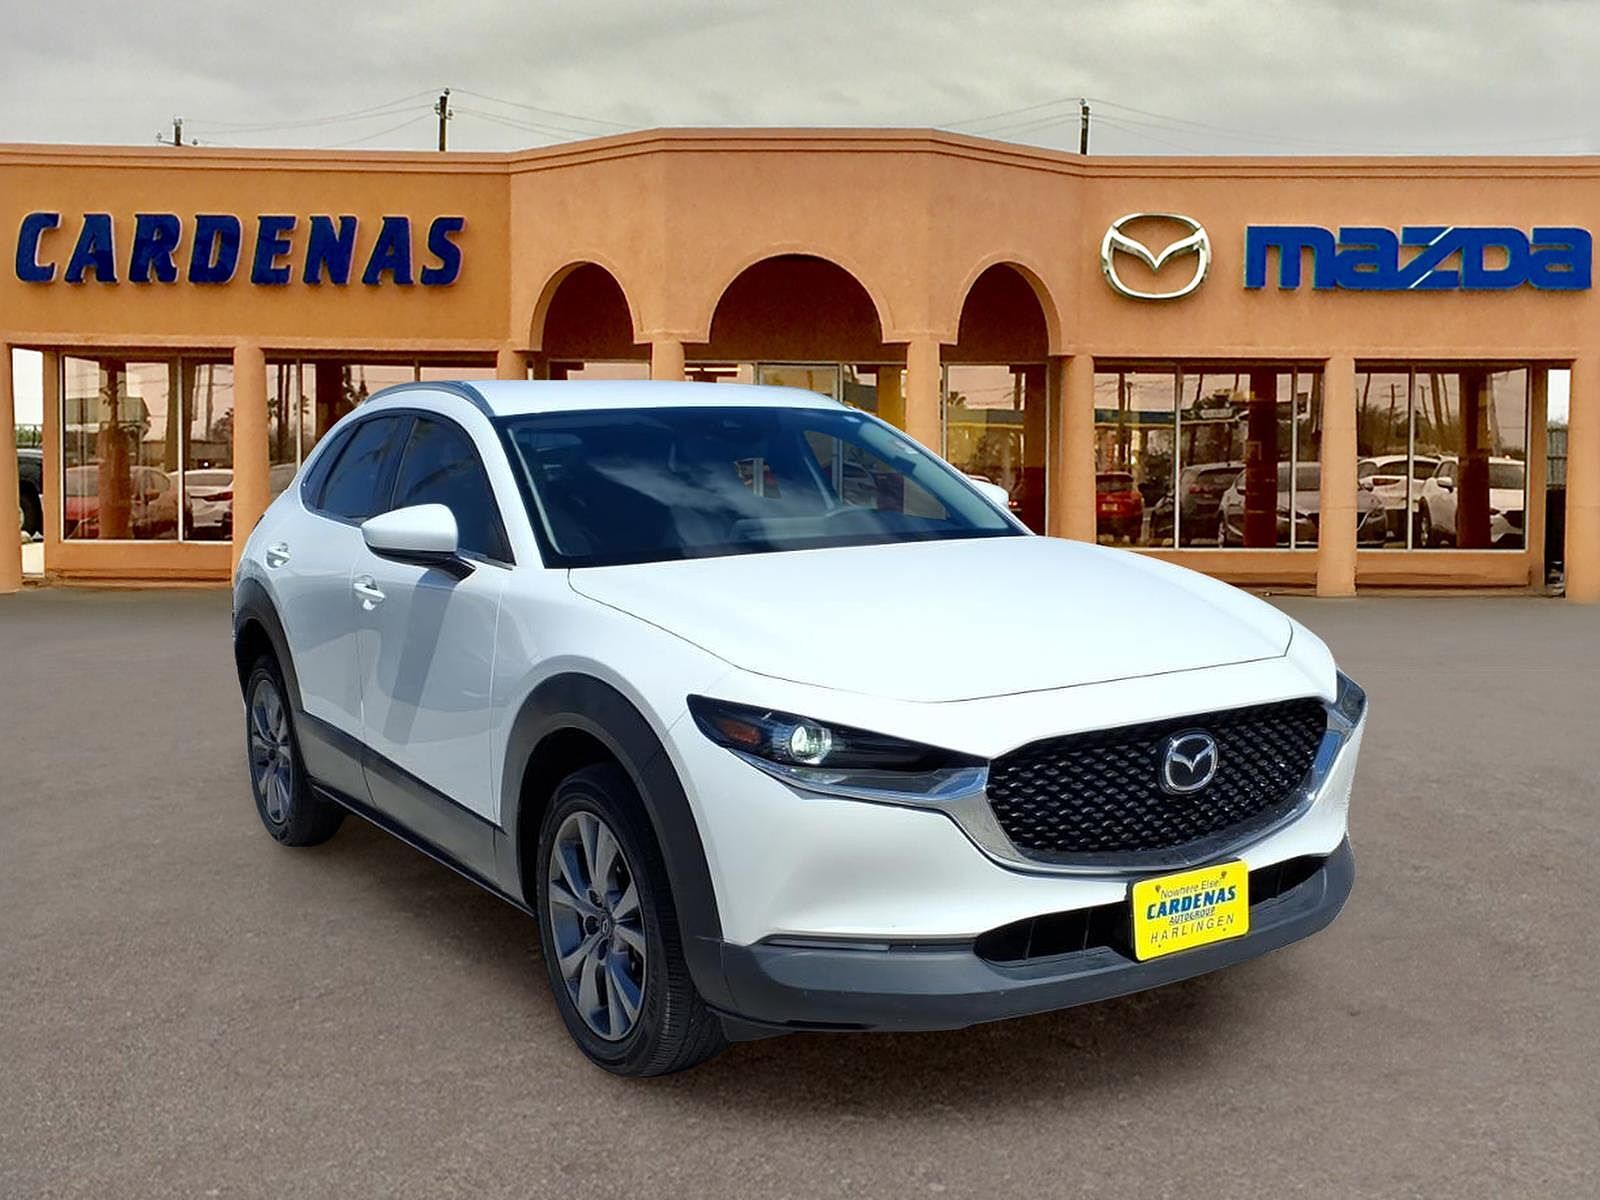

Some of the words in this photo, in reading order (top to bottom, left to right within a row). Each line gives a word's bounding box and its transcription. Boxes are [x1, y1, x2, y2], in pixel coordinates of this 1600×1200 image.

[15, 211, 467, 286] CARDENAS
[1146, 885, 1237, 920] CARDENAS
[1151, 914, 1235, 944] HARLINGEN
